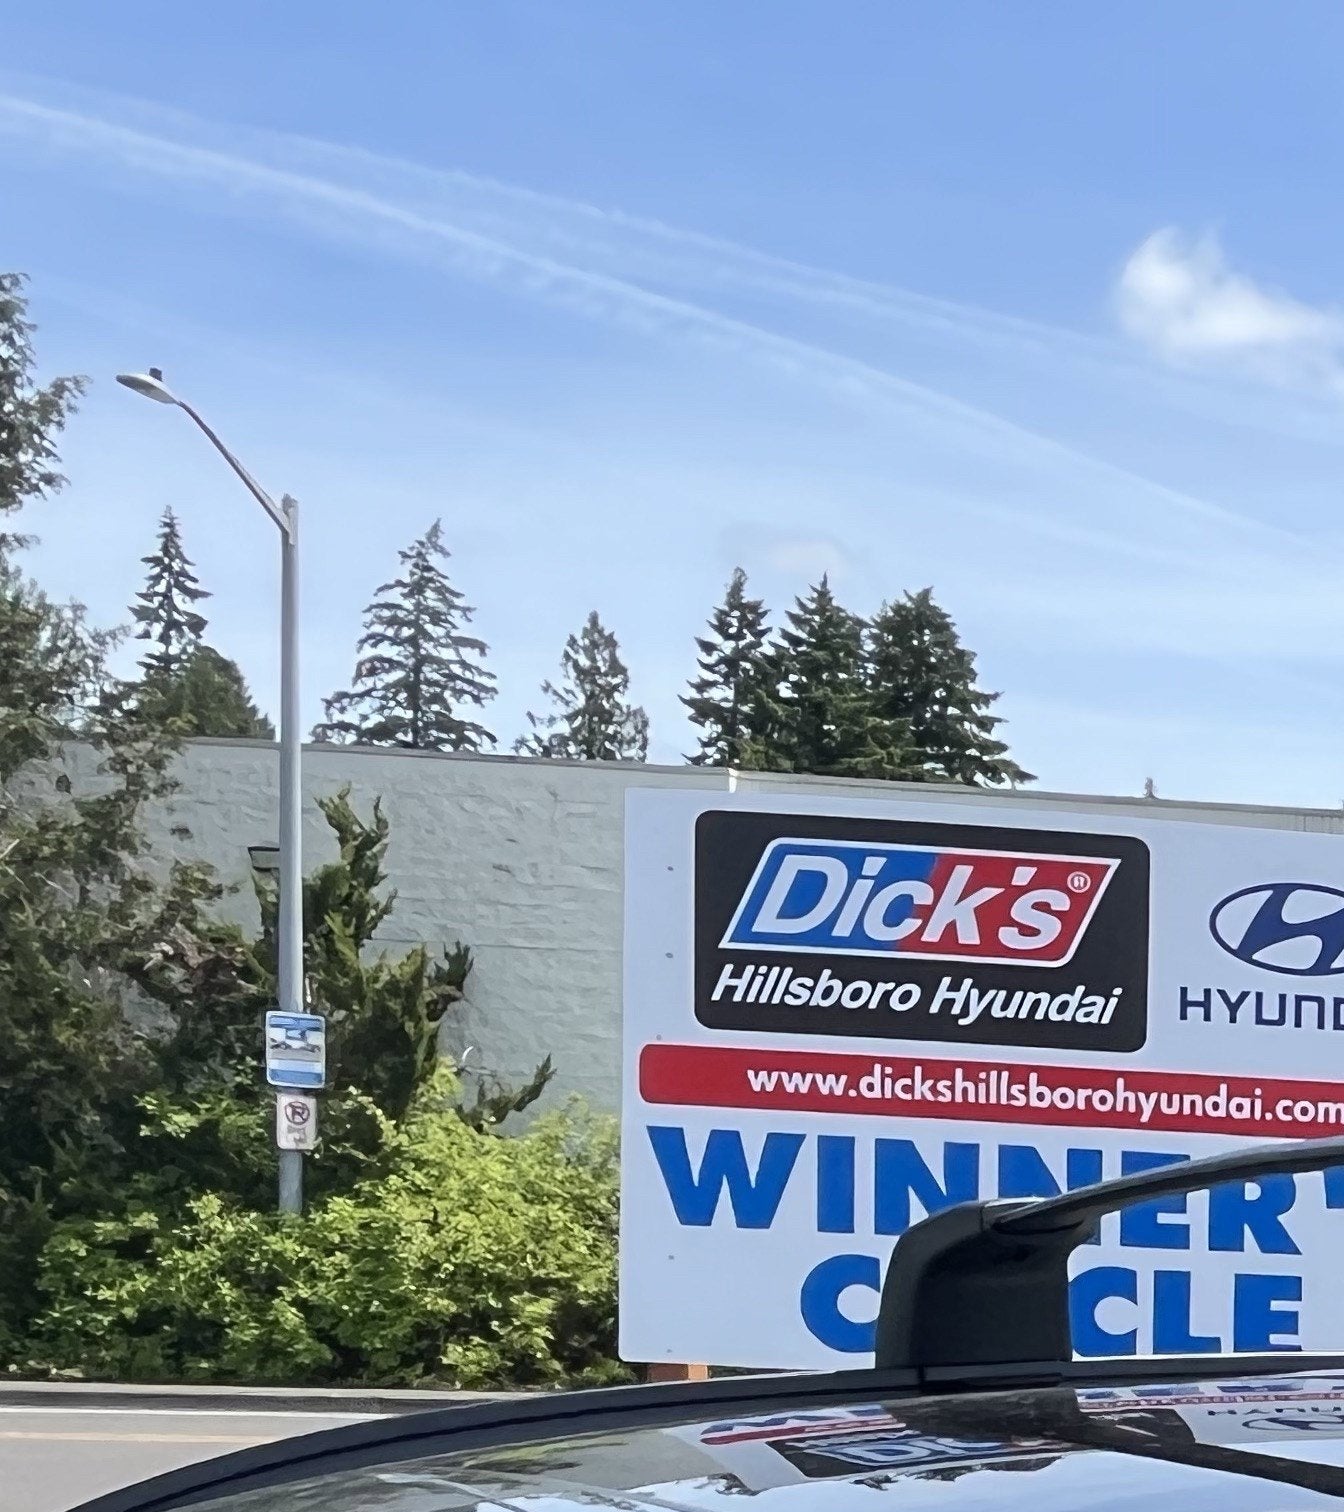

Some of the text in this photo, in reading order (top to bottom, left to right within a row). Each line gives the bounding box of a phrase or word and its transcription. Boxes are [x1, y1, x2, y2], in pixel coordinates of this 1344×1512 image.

[751, 854, 1071, 950] Dick's
[711, 963, 1123, 1026] Hillsboro Hyundai
[800, 1253, 1303, 1358] CCLE
